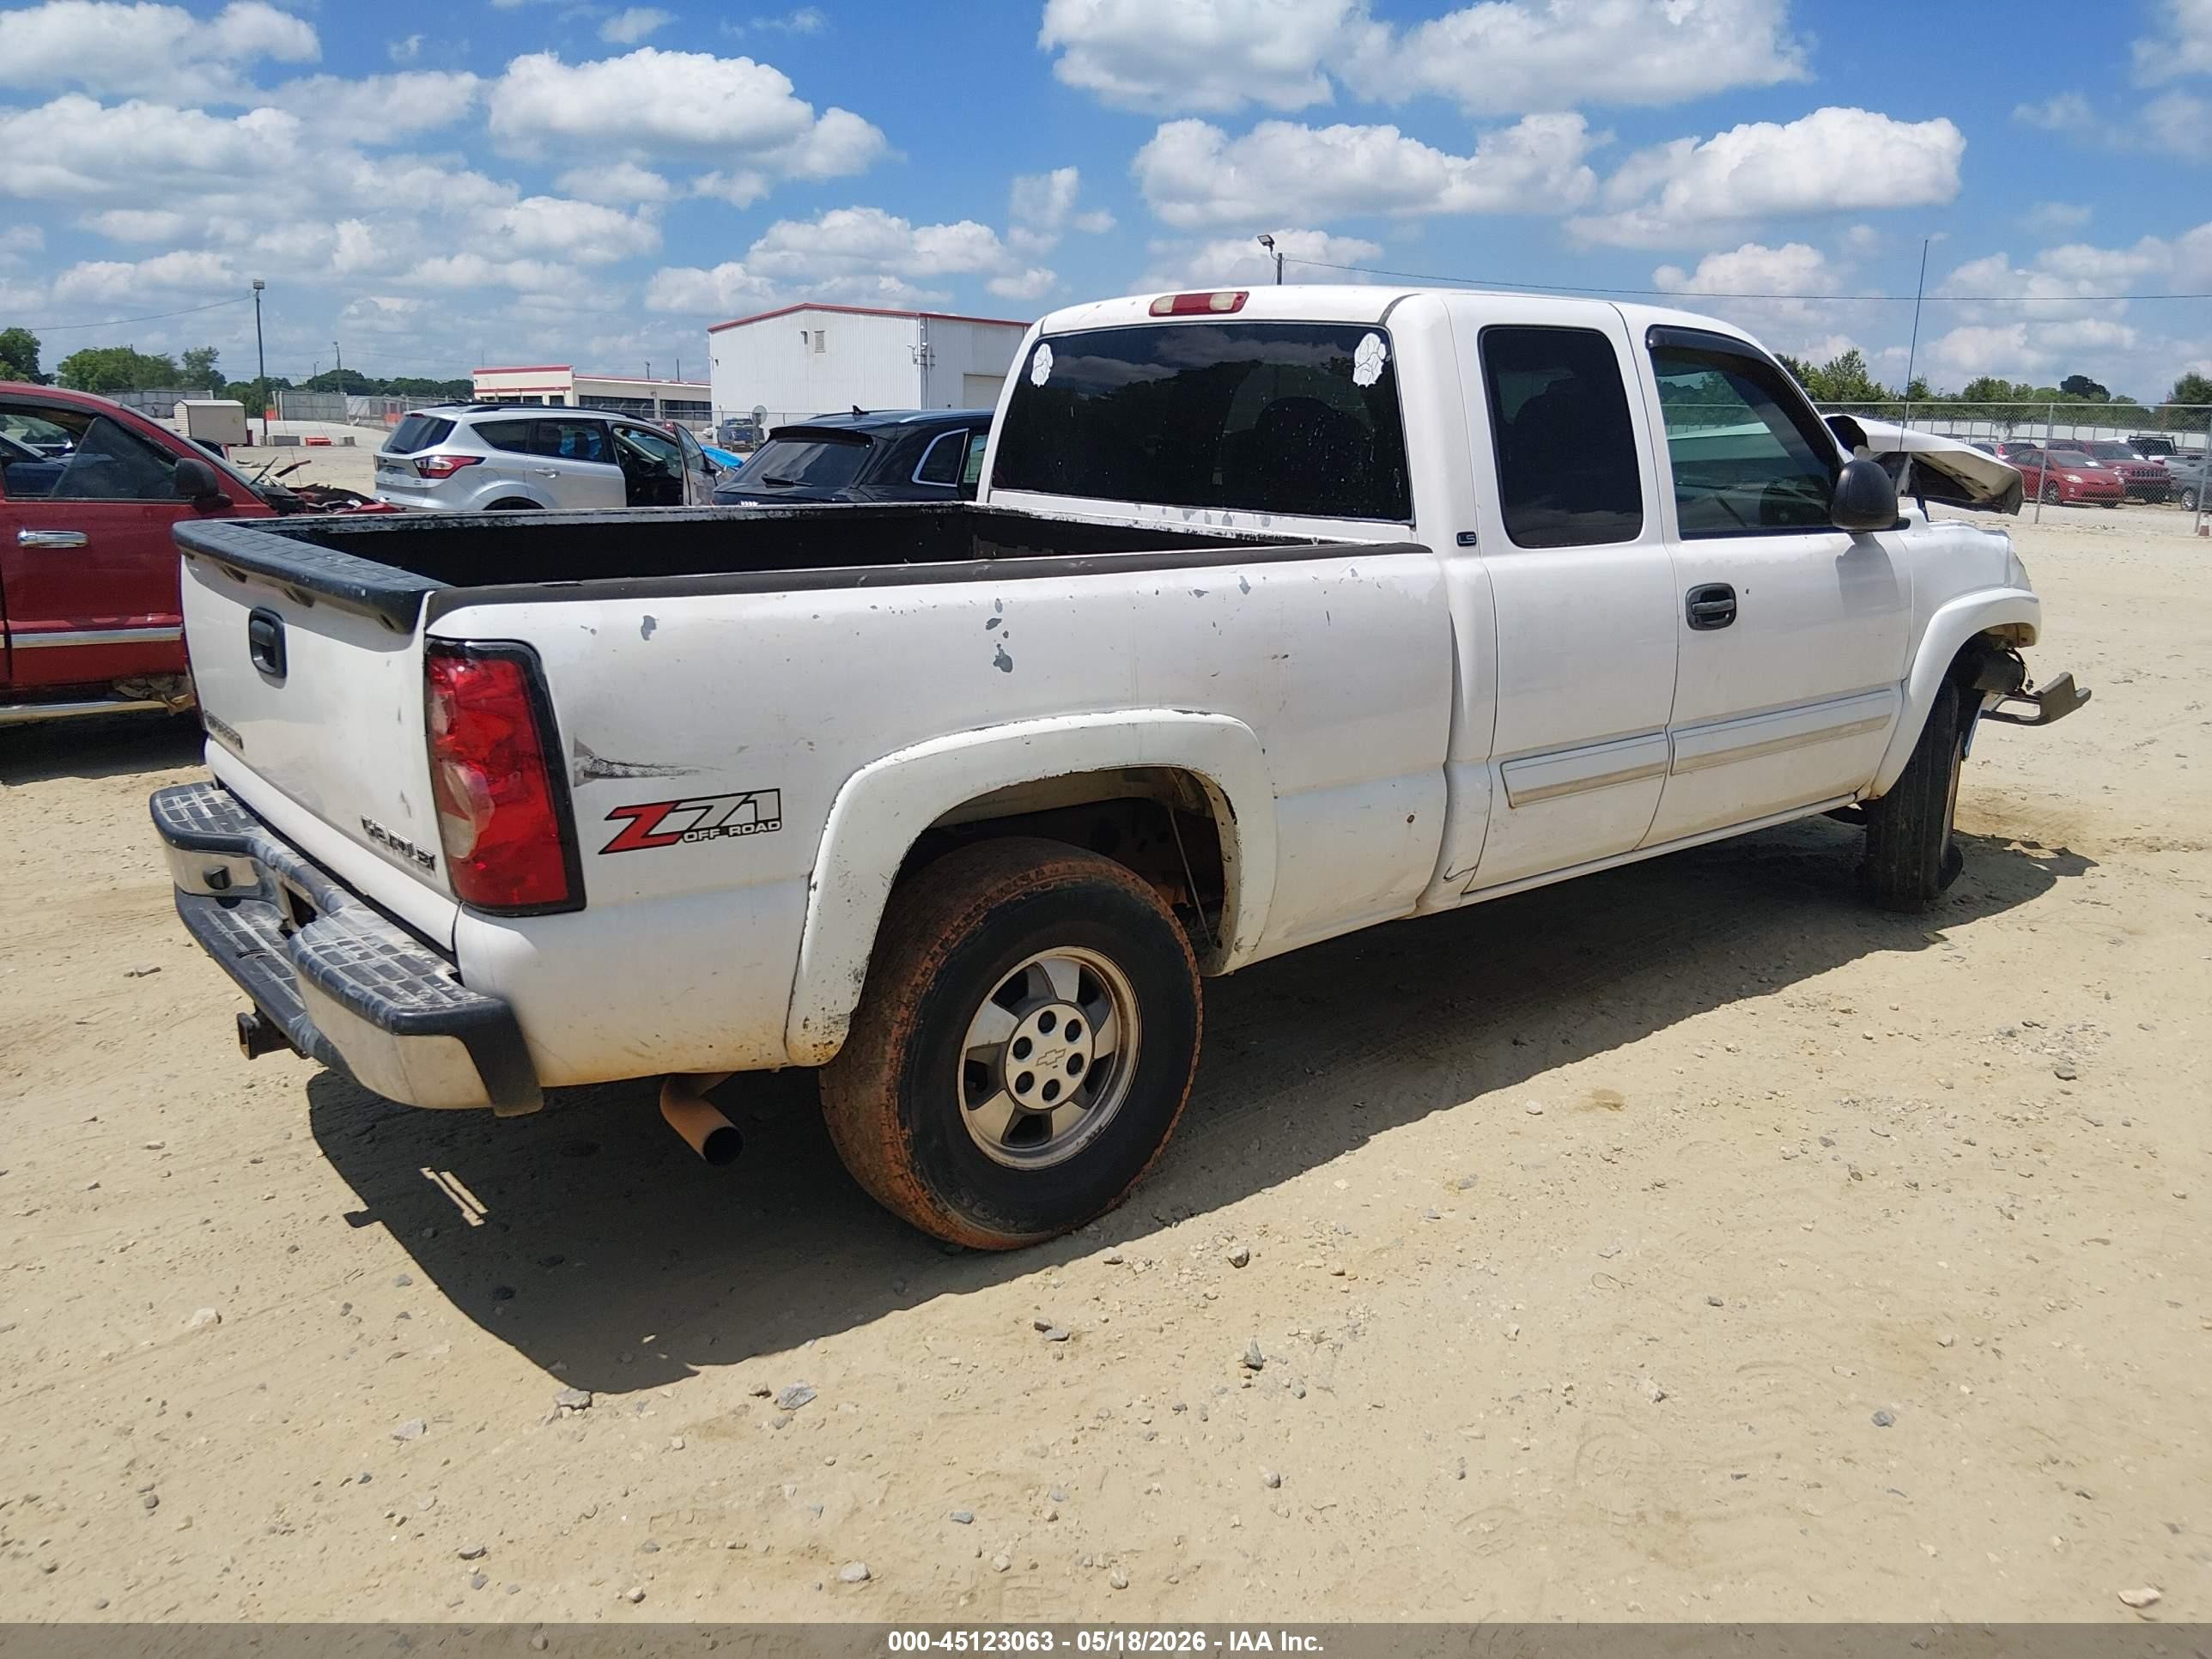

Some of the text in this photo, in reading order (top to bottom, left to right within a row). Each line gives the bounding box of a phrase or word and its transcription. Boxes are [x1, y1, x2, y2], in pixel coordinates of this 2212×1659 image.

[1457, 534, 1476, 544] LS
[598, 787, 781, 855] Z71
[684, 820, 781, 843] OFF ROAD
